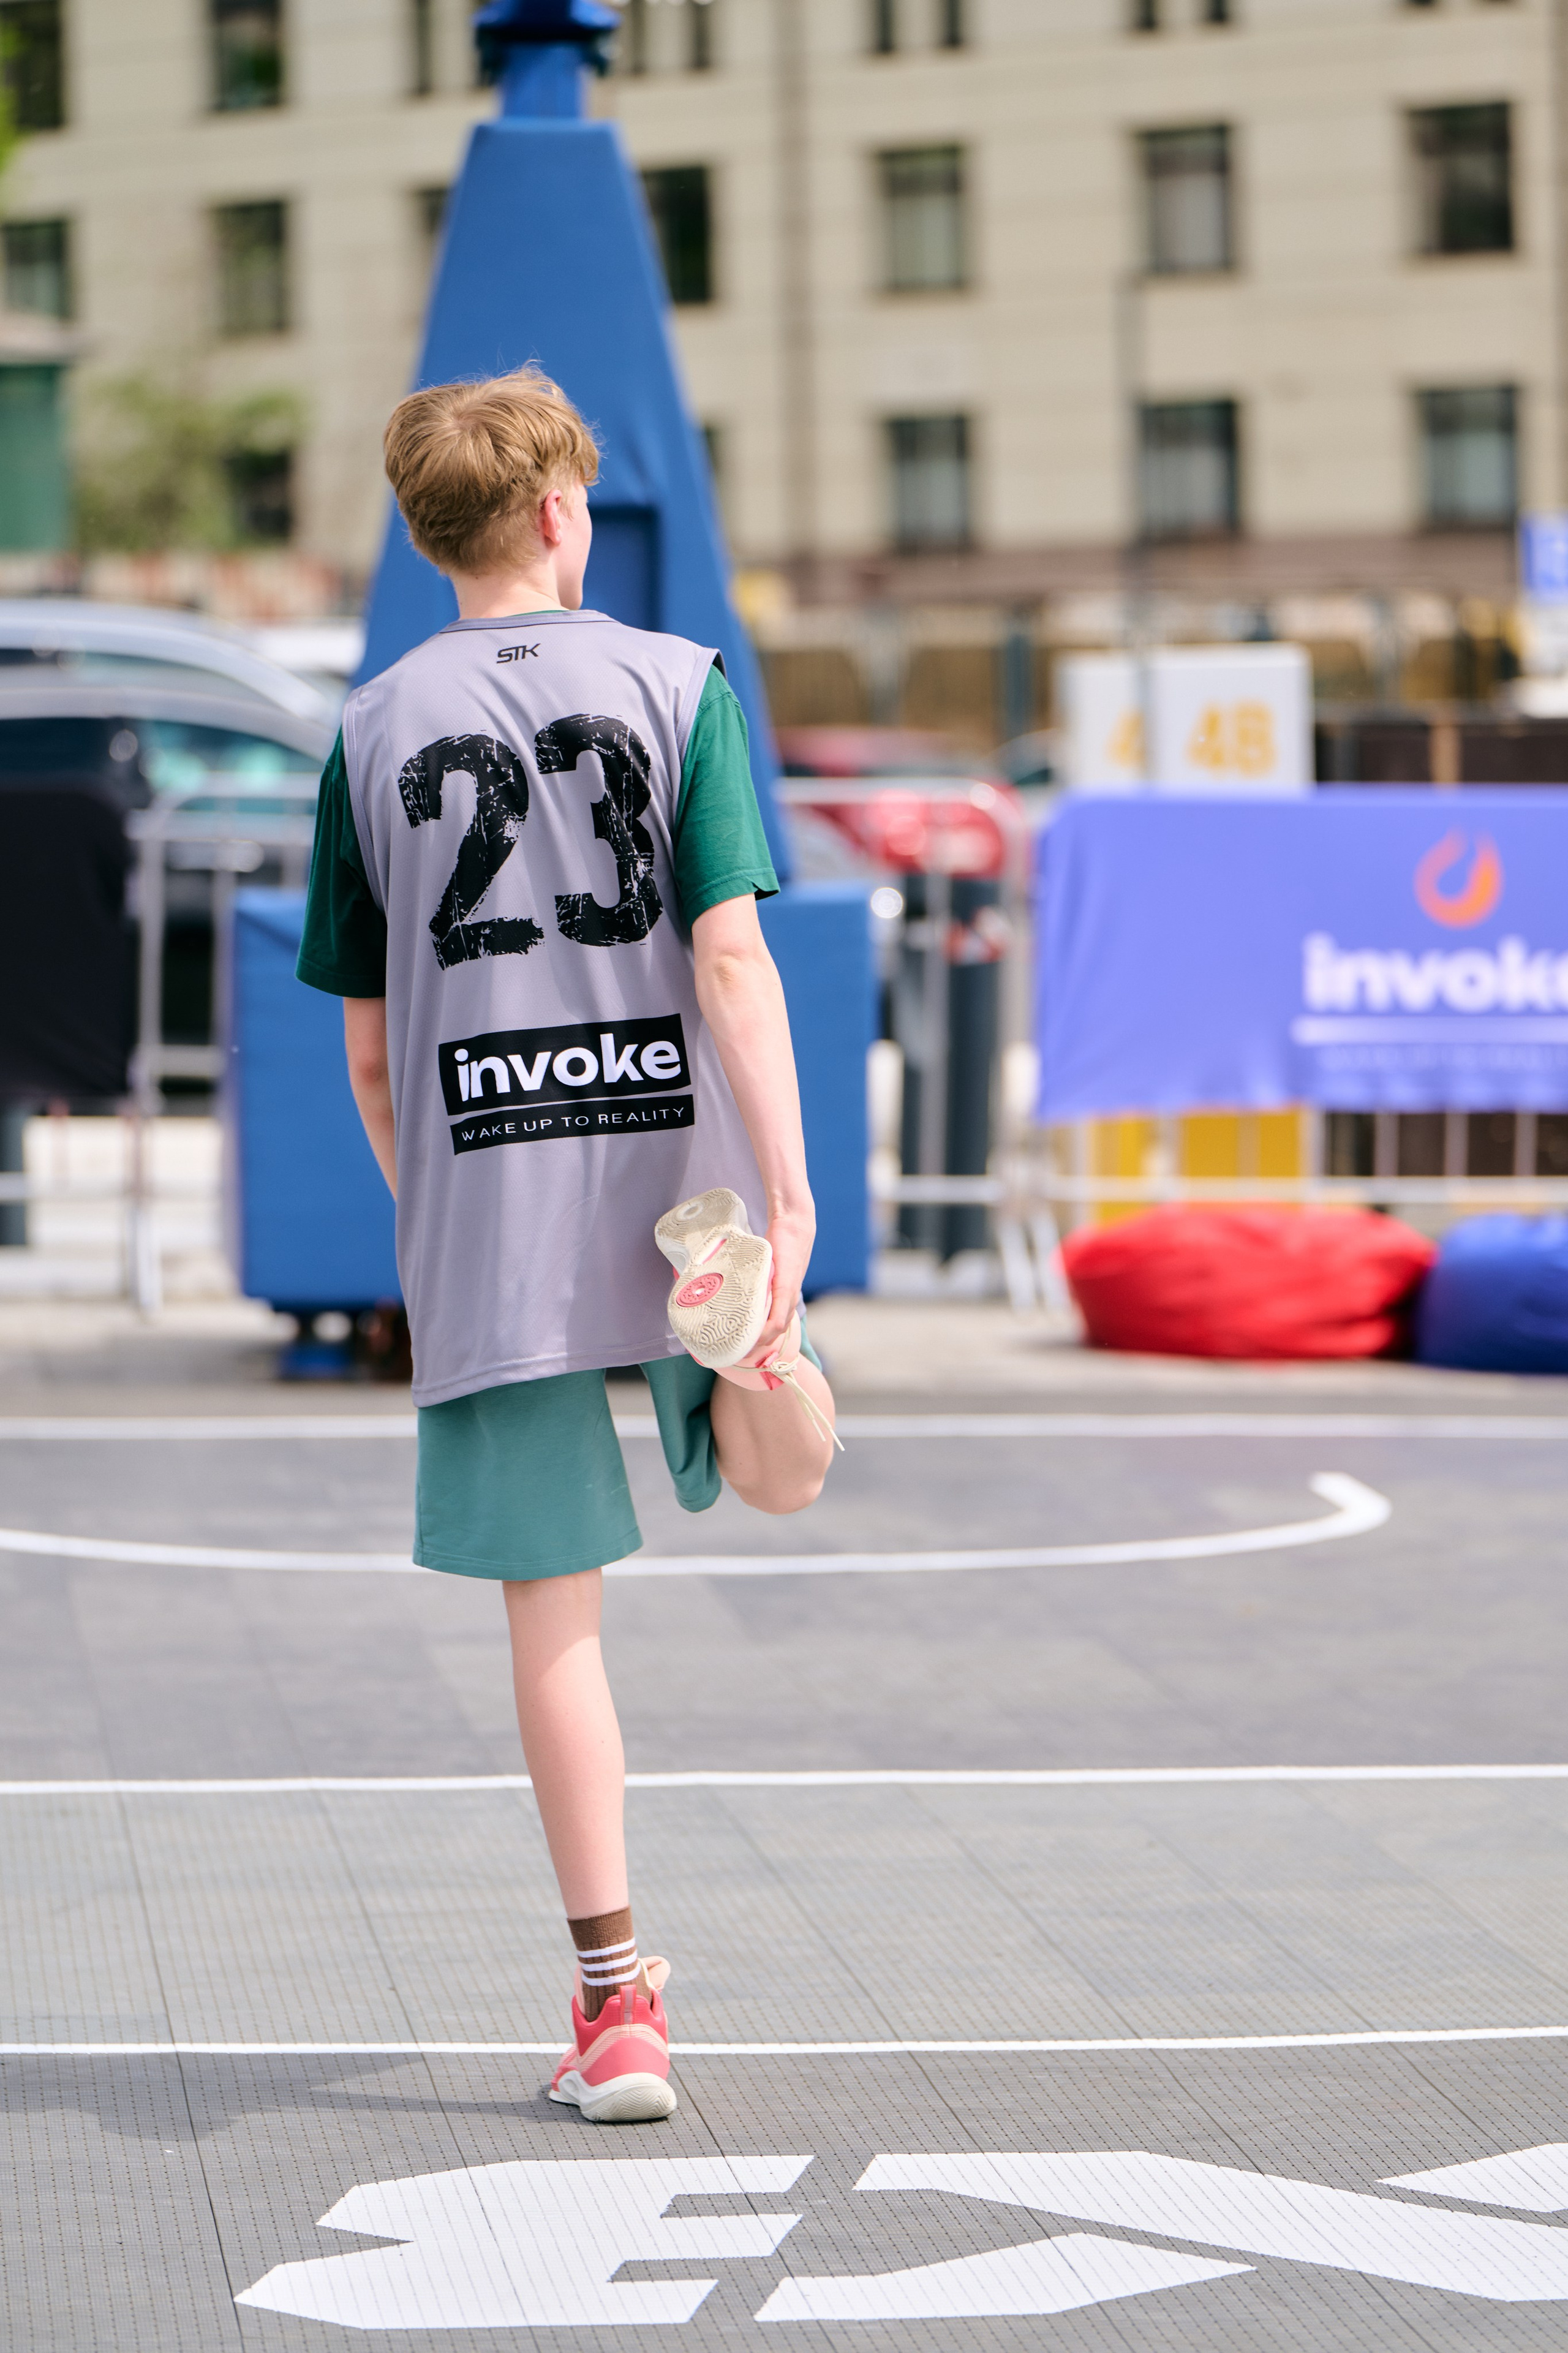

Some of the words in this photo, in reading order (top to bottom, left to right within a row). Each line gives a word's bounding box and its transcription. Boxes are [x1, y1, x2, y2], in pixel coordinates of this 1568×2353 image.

[496, 643, 541, 664] STK
[398, 713, 663, 971] 23
[1303, 932, 1568, 1013] invok
[454, 1032, 681, 1102] invoke
[461, 1122, 516, 1141] WAKE
[523, 1119, 552, 1131] UP
[560, 1116, 589, 1127] TO
[598, 1107, 684, 1124] REALITY
